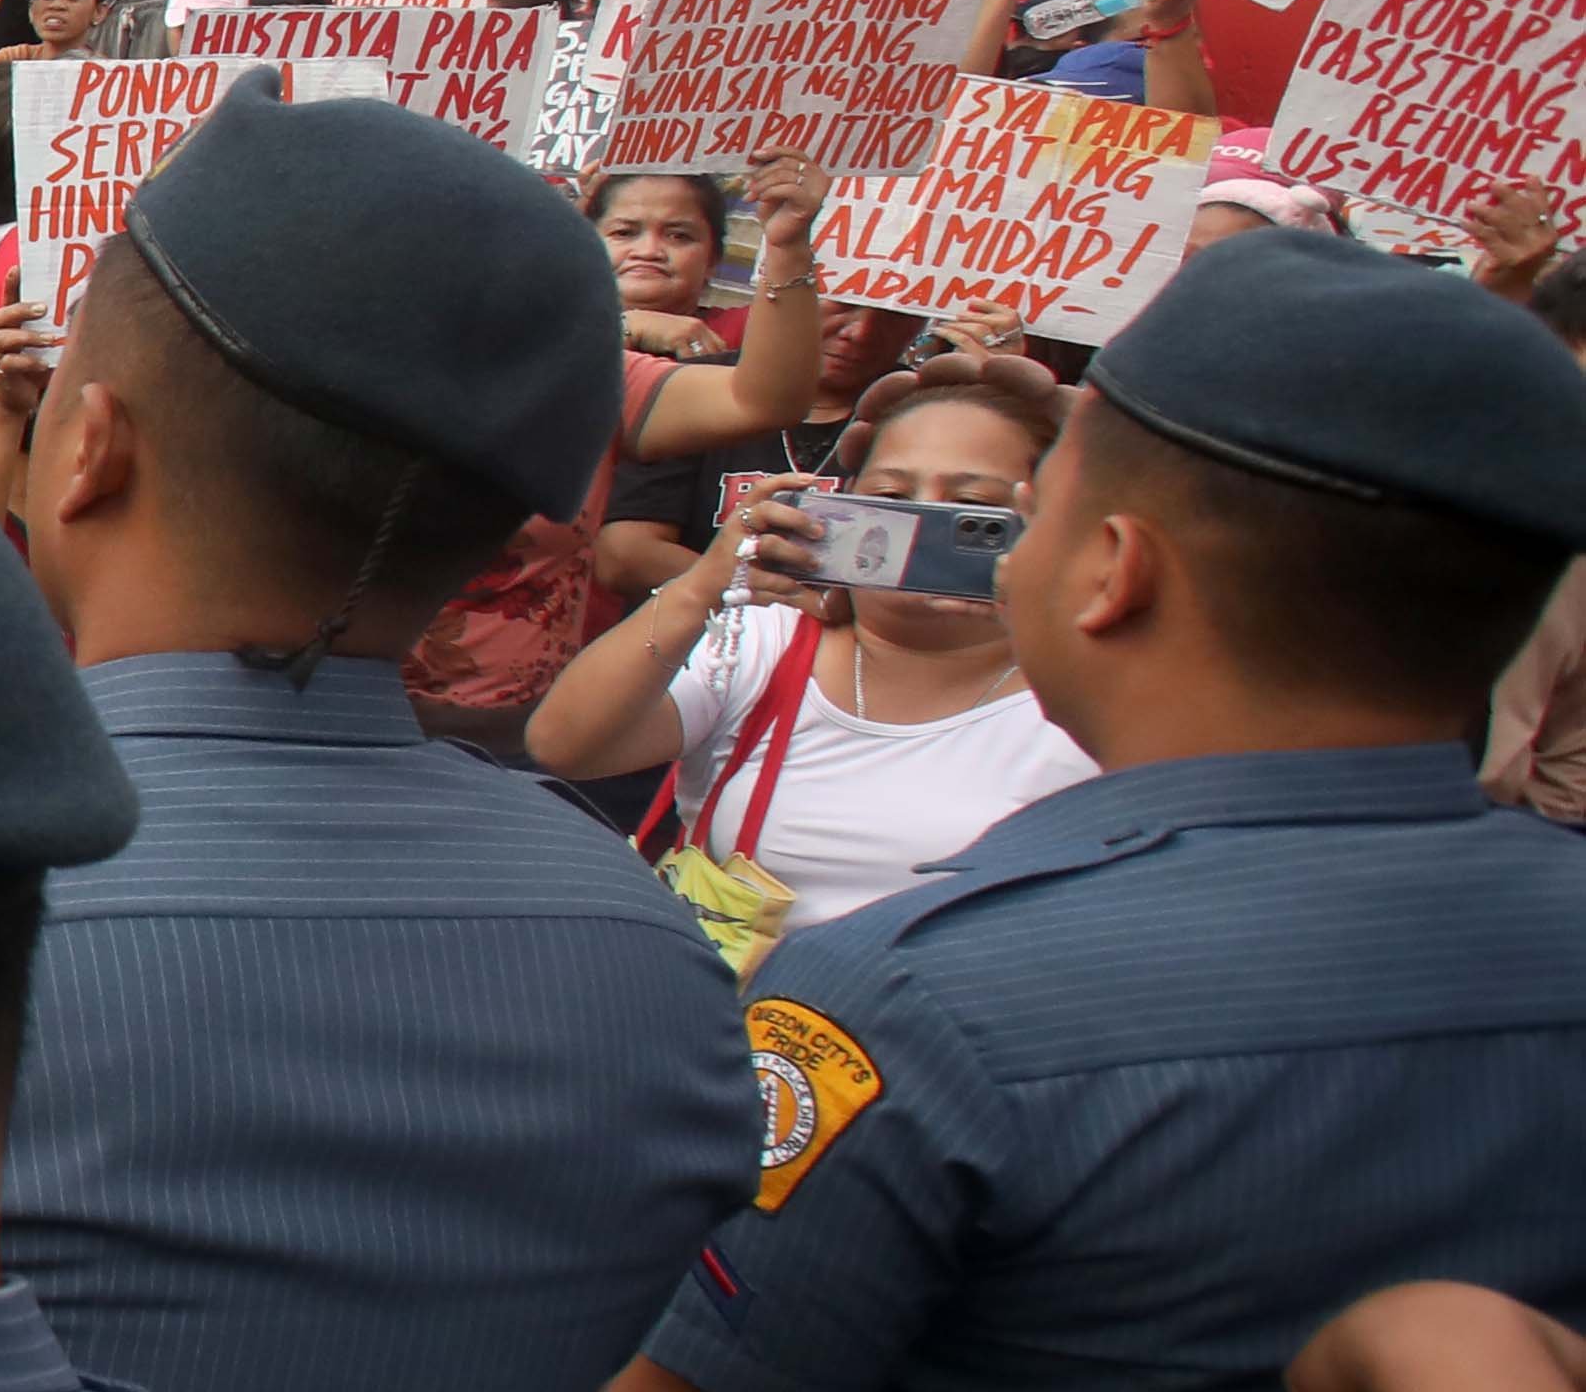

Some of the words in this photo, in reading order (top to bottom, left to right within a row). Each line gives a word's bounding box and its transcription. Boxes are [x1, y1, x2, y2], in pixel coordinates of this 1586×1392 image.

[415, 10, 540, 73] PARA
[631, 20, 922, 74] KABUHAYANG
[69, 61, 219, 121] PONDO
[435, 73, 509, 121] NG
[623, 64, 799, 117] WINASAK
[801, 65, 850, 101] NG
[845, 64, 957, 113] BAGYO
[1299, 20, 1577, 142] PASISTANG
[603, 117, 701, 167] HINDI
[704, 116, 752, 155] SA
[1069, 99, 1194, 156] PARA
[1070, 149, 1159, 200] NG
[1026, 182, 1110, 227] NG
[813, 205, 1160, 288] ALAMIDAD!
[763, 1026, 825, 1071] PRIDE
